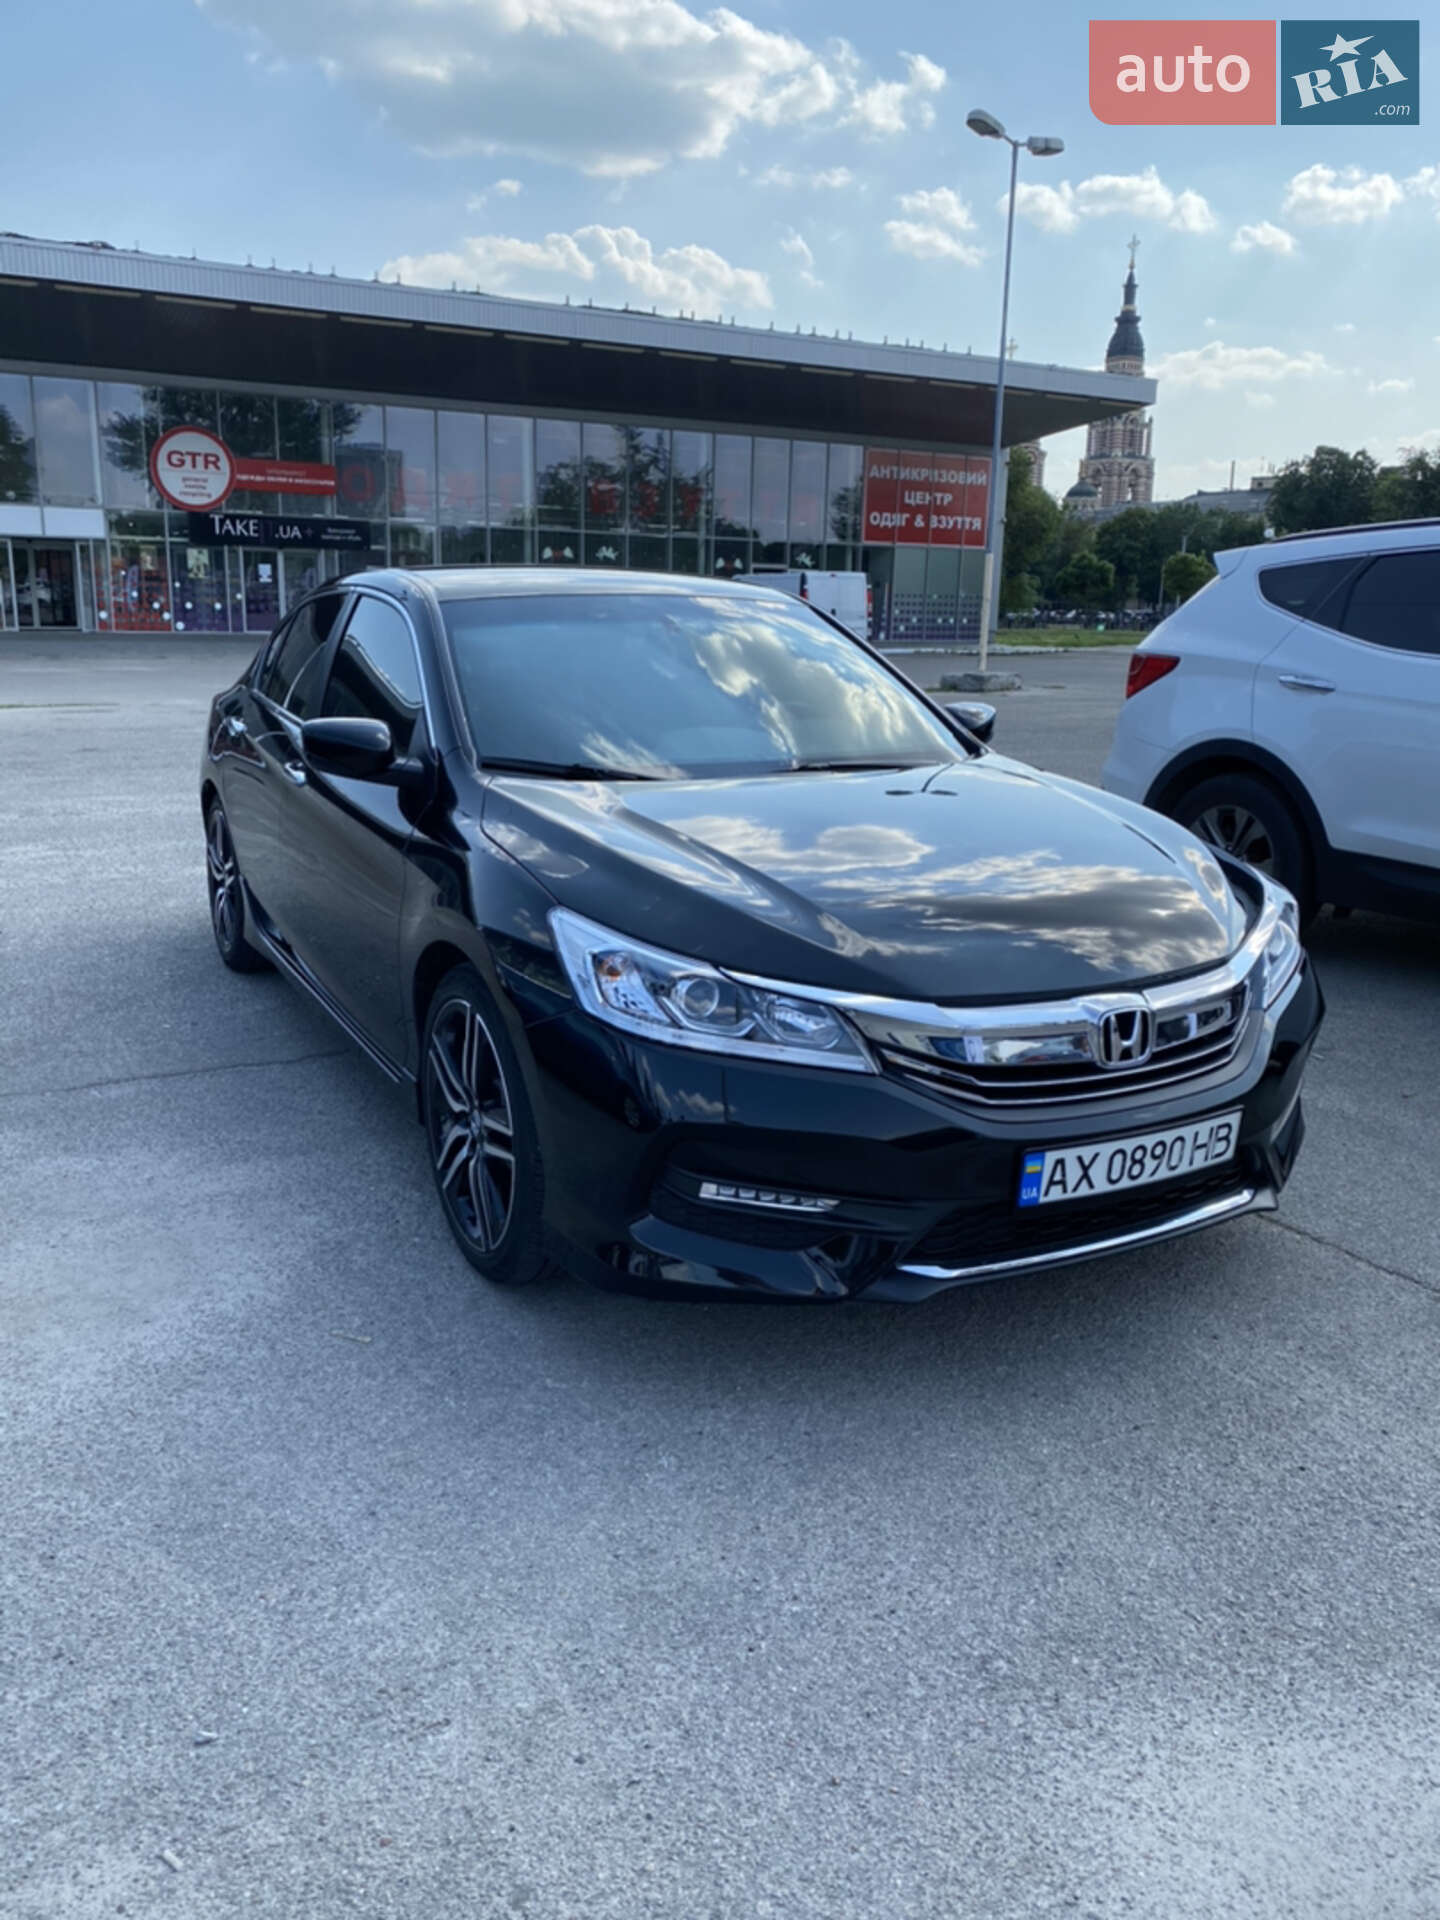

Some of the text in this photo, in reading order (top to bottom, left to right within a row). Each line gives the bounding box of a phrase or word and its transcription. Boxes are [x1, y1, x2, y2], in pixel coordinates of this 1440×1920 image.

[166, 450, 221, 471] GTR
[869, 464, 987, 486] АНТИКРИЗОВИЙ
[903, 490, 953, 507] ЦЕНТР
[209, 513, 259, 537] TAKE
[869, 511, 983, 531] ОДЯГ & ВЗУТТЯ
[1043, 1122, 1233, 1198] AX 0890 HB
